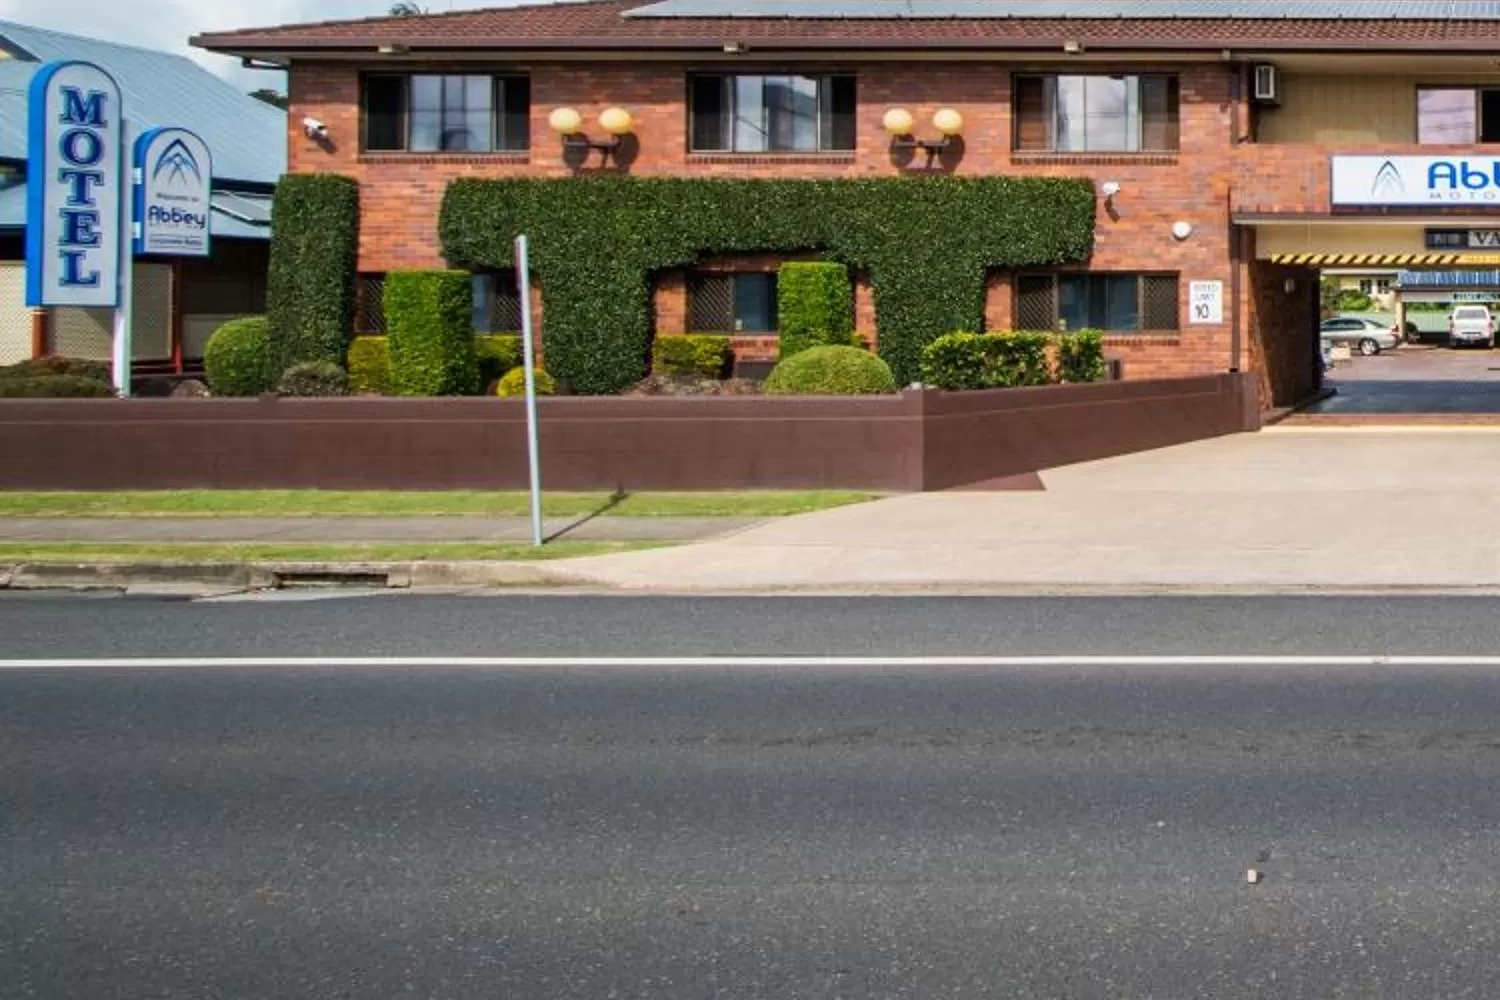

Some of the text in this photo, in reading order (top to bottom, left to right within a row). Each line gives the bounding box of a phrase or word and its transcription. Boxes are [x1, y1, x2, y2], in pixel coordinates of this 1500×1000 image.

[58, 86, 107, 286] MOTEL
[149, 205, 206, 229] Abbey
[1195, 303, 1209, 320] 10
